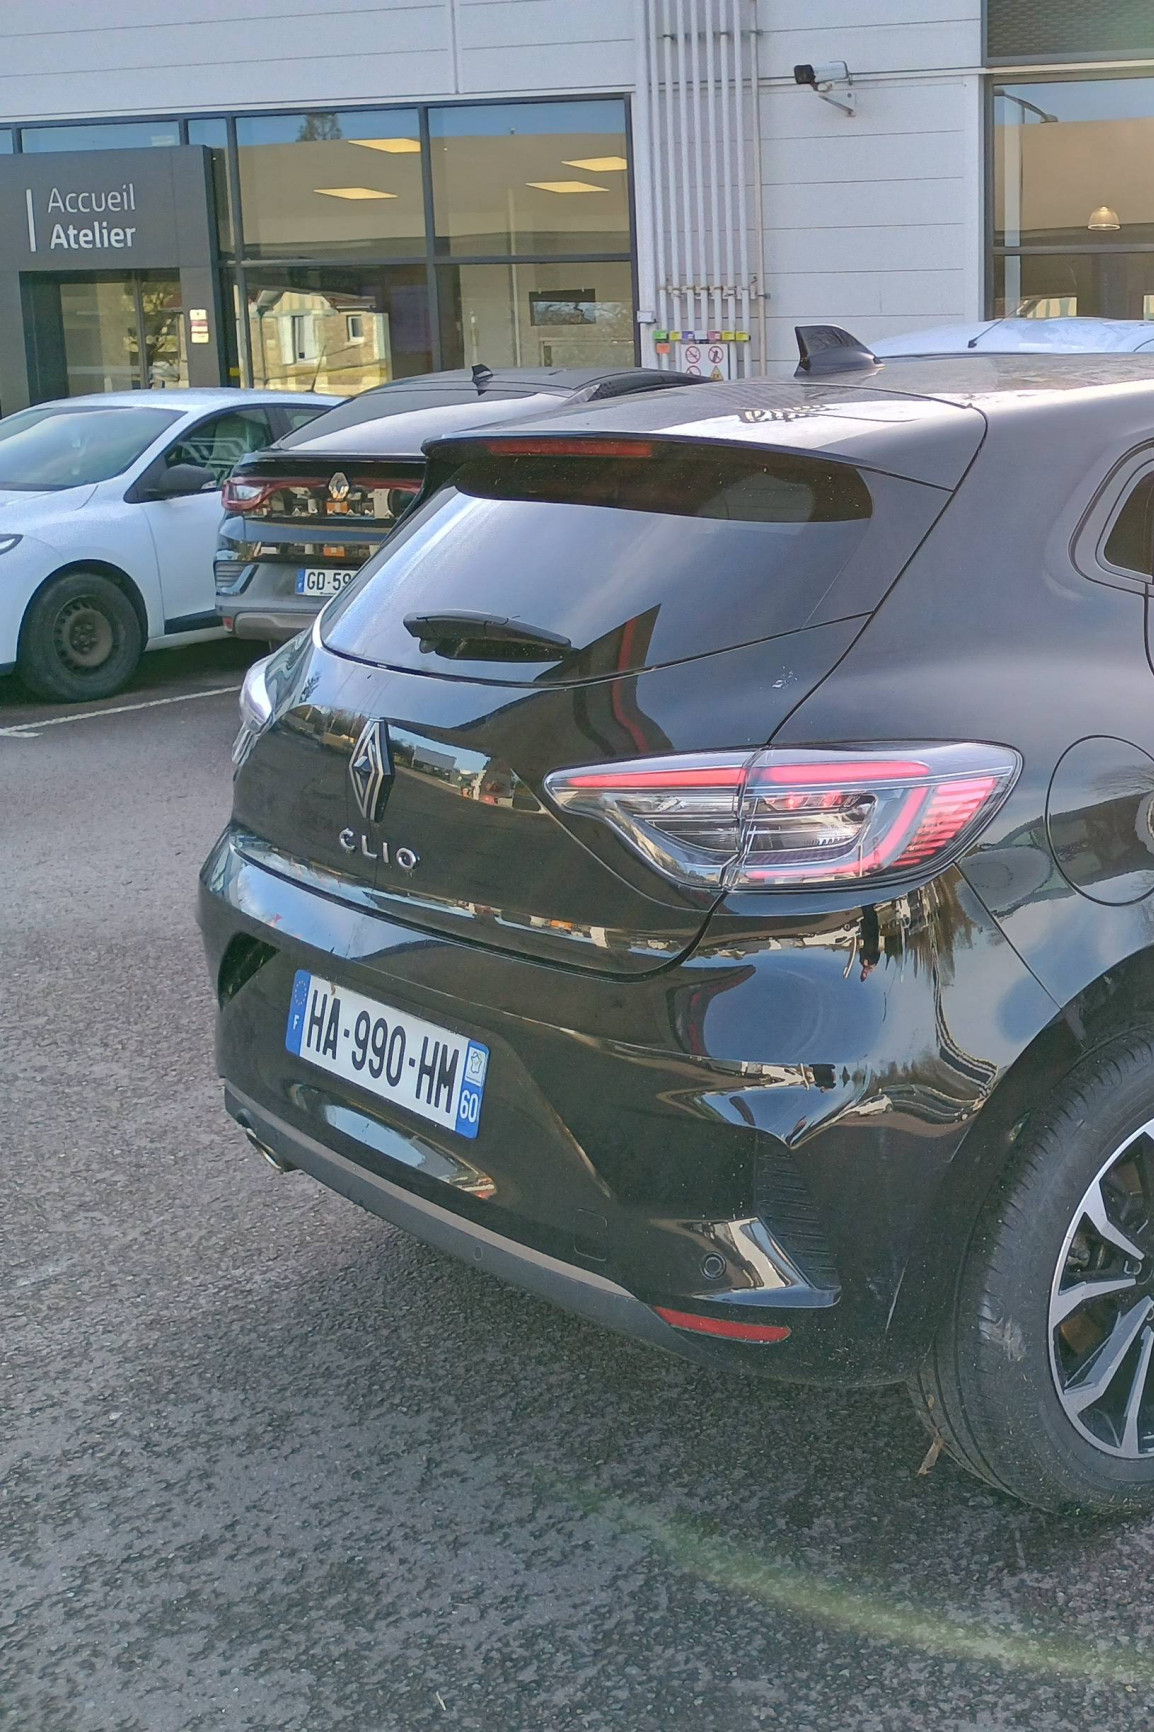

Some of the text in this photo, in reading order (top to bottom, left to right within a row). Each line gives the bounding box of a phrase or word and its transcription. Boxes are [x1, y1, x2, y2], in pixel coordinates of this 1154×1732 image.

[48, 183, 136, 213] Accueil
[50, 221, 136, 249] Atelier
[339, 828, 417, 870] CLIO
[292, 989, 480, 1123] F HA-990-HM 60
